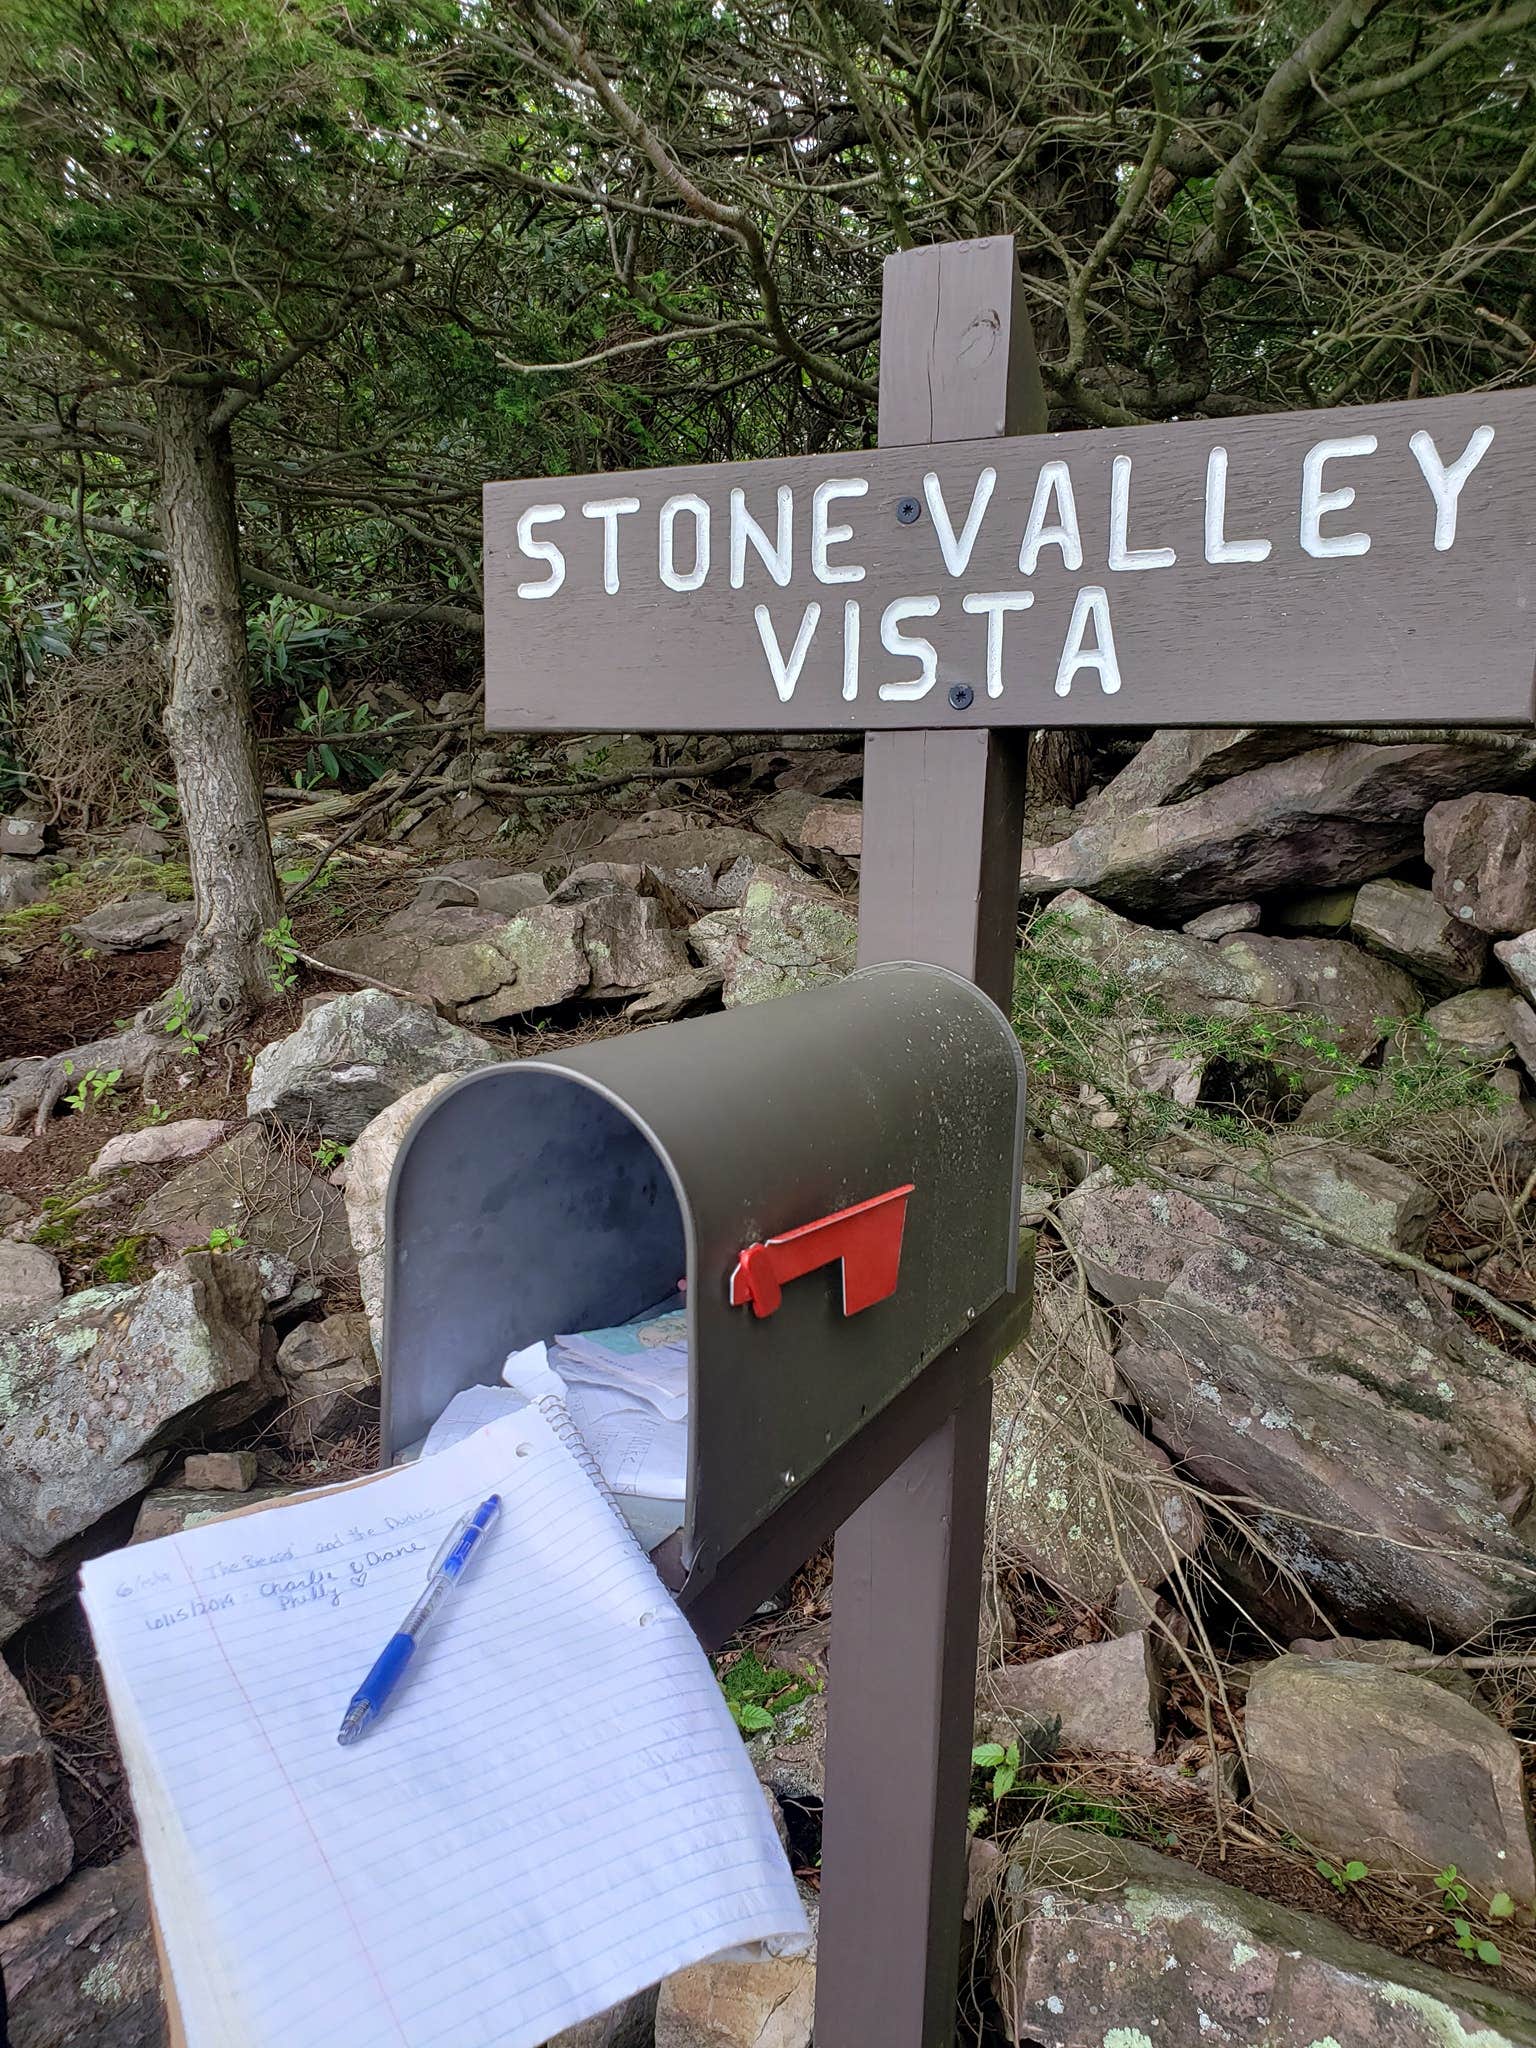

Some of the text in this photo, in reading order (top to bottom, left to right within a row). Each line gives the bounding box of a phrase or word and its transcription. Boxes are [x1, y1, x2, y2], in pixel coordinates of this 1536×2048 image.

[516, 425, 1495, 600] STONE VALLEY
[754, 586, 1122, 702] VISTA
[365, 1541, 426, 1567] Diane
